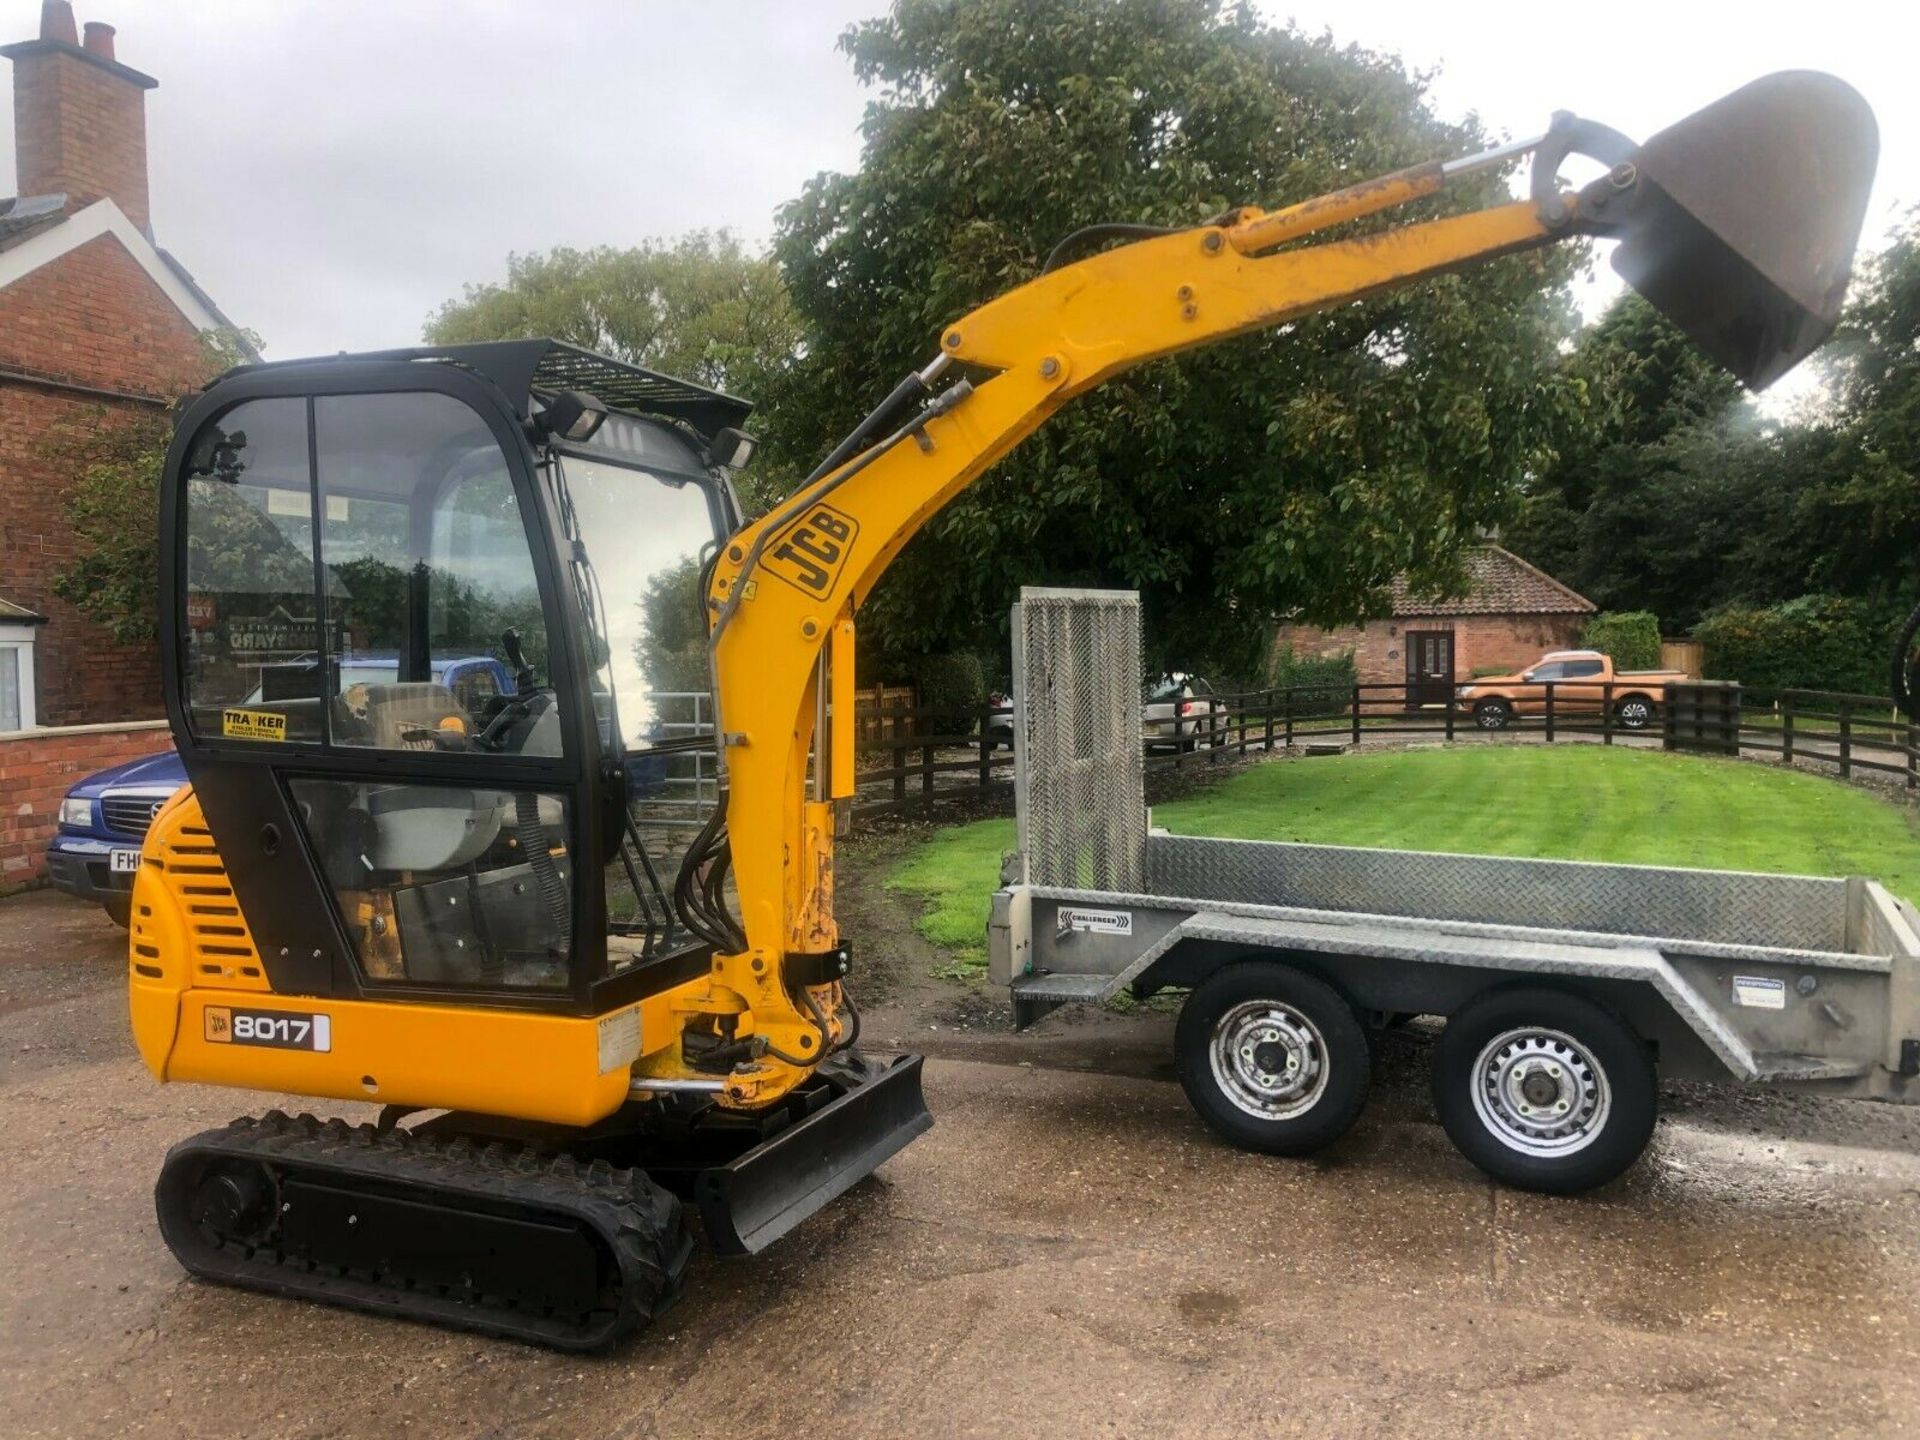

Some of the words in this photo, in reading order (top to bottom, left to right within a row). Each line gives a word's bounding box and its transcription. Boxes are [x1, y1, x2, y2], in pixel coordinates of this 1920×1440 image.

[773, 511, 850, 591] JCB
[225, 712, 283, 729] TRAKER
[1072, 915, 1117, 924] CHALLENGER
[234, 1015, 311, 1042] 8017
